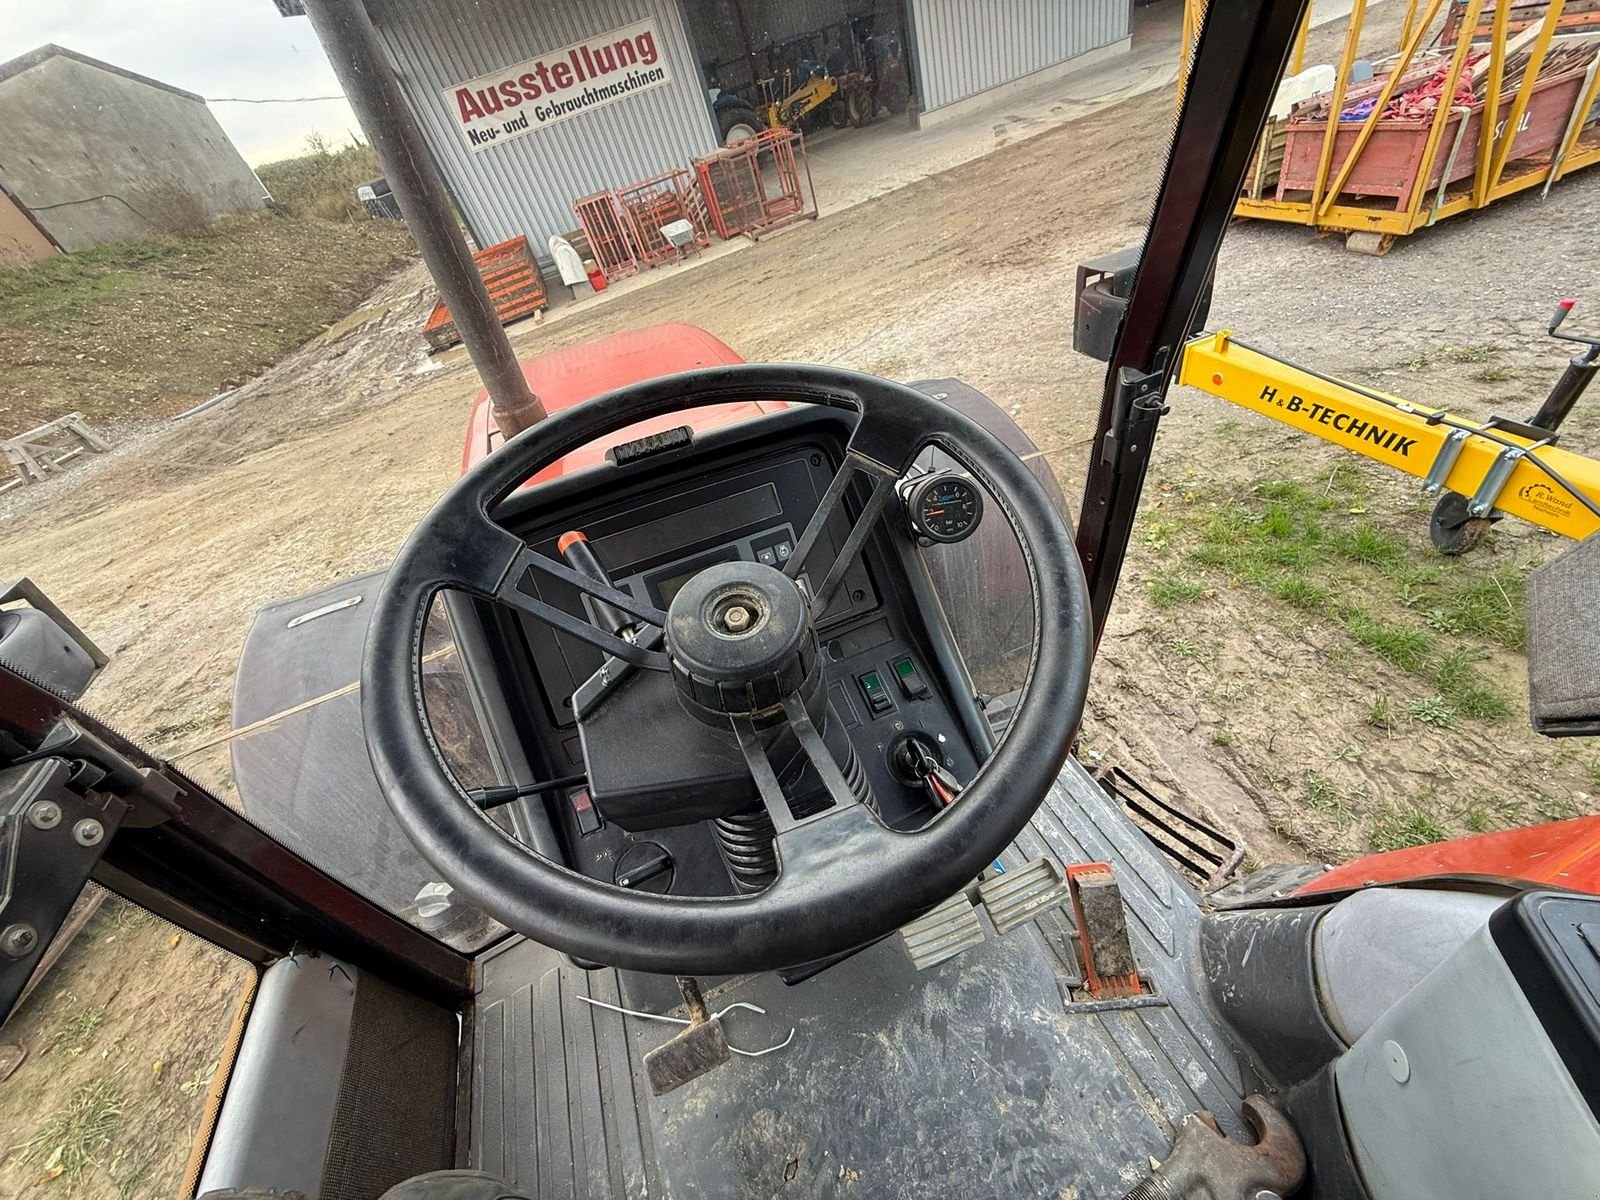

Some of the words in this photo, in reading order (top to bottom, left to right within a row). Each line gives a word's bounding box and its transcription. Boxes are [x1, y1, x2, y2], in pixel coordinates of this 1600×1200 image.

[455, 30, 657, 123] Ausstellung
[467, 128, 500, 146] Neu-
[503, 110, 529, 134] und
[535, 67, 665, 122] Gebrauchtmaschinen
